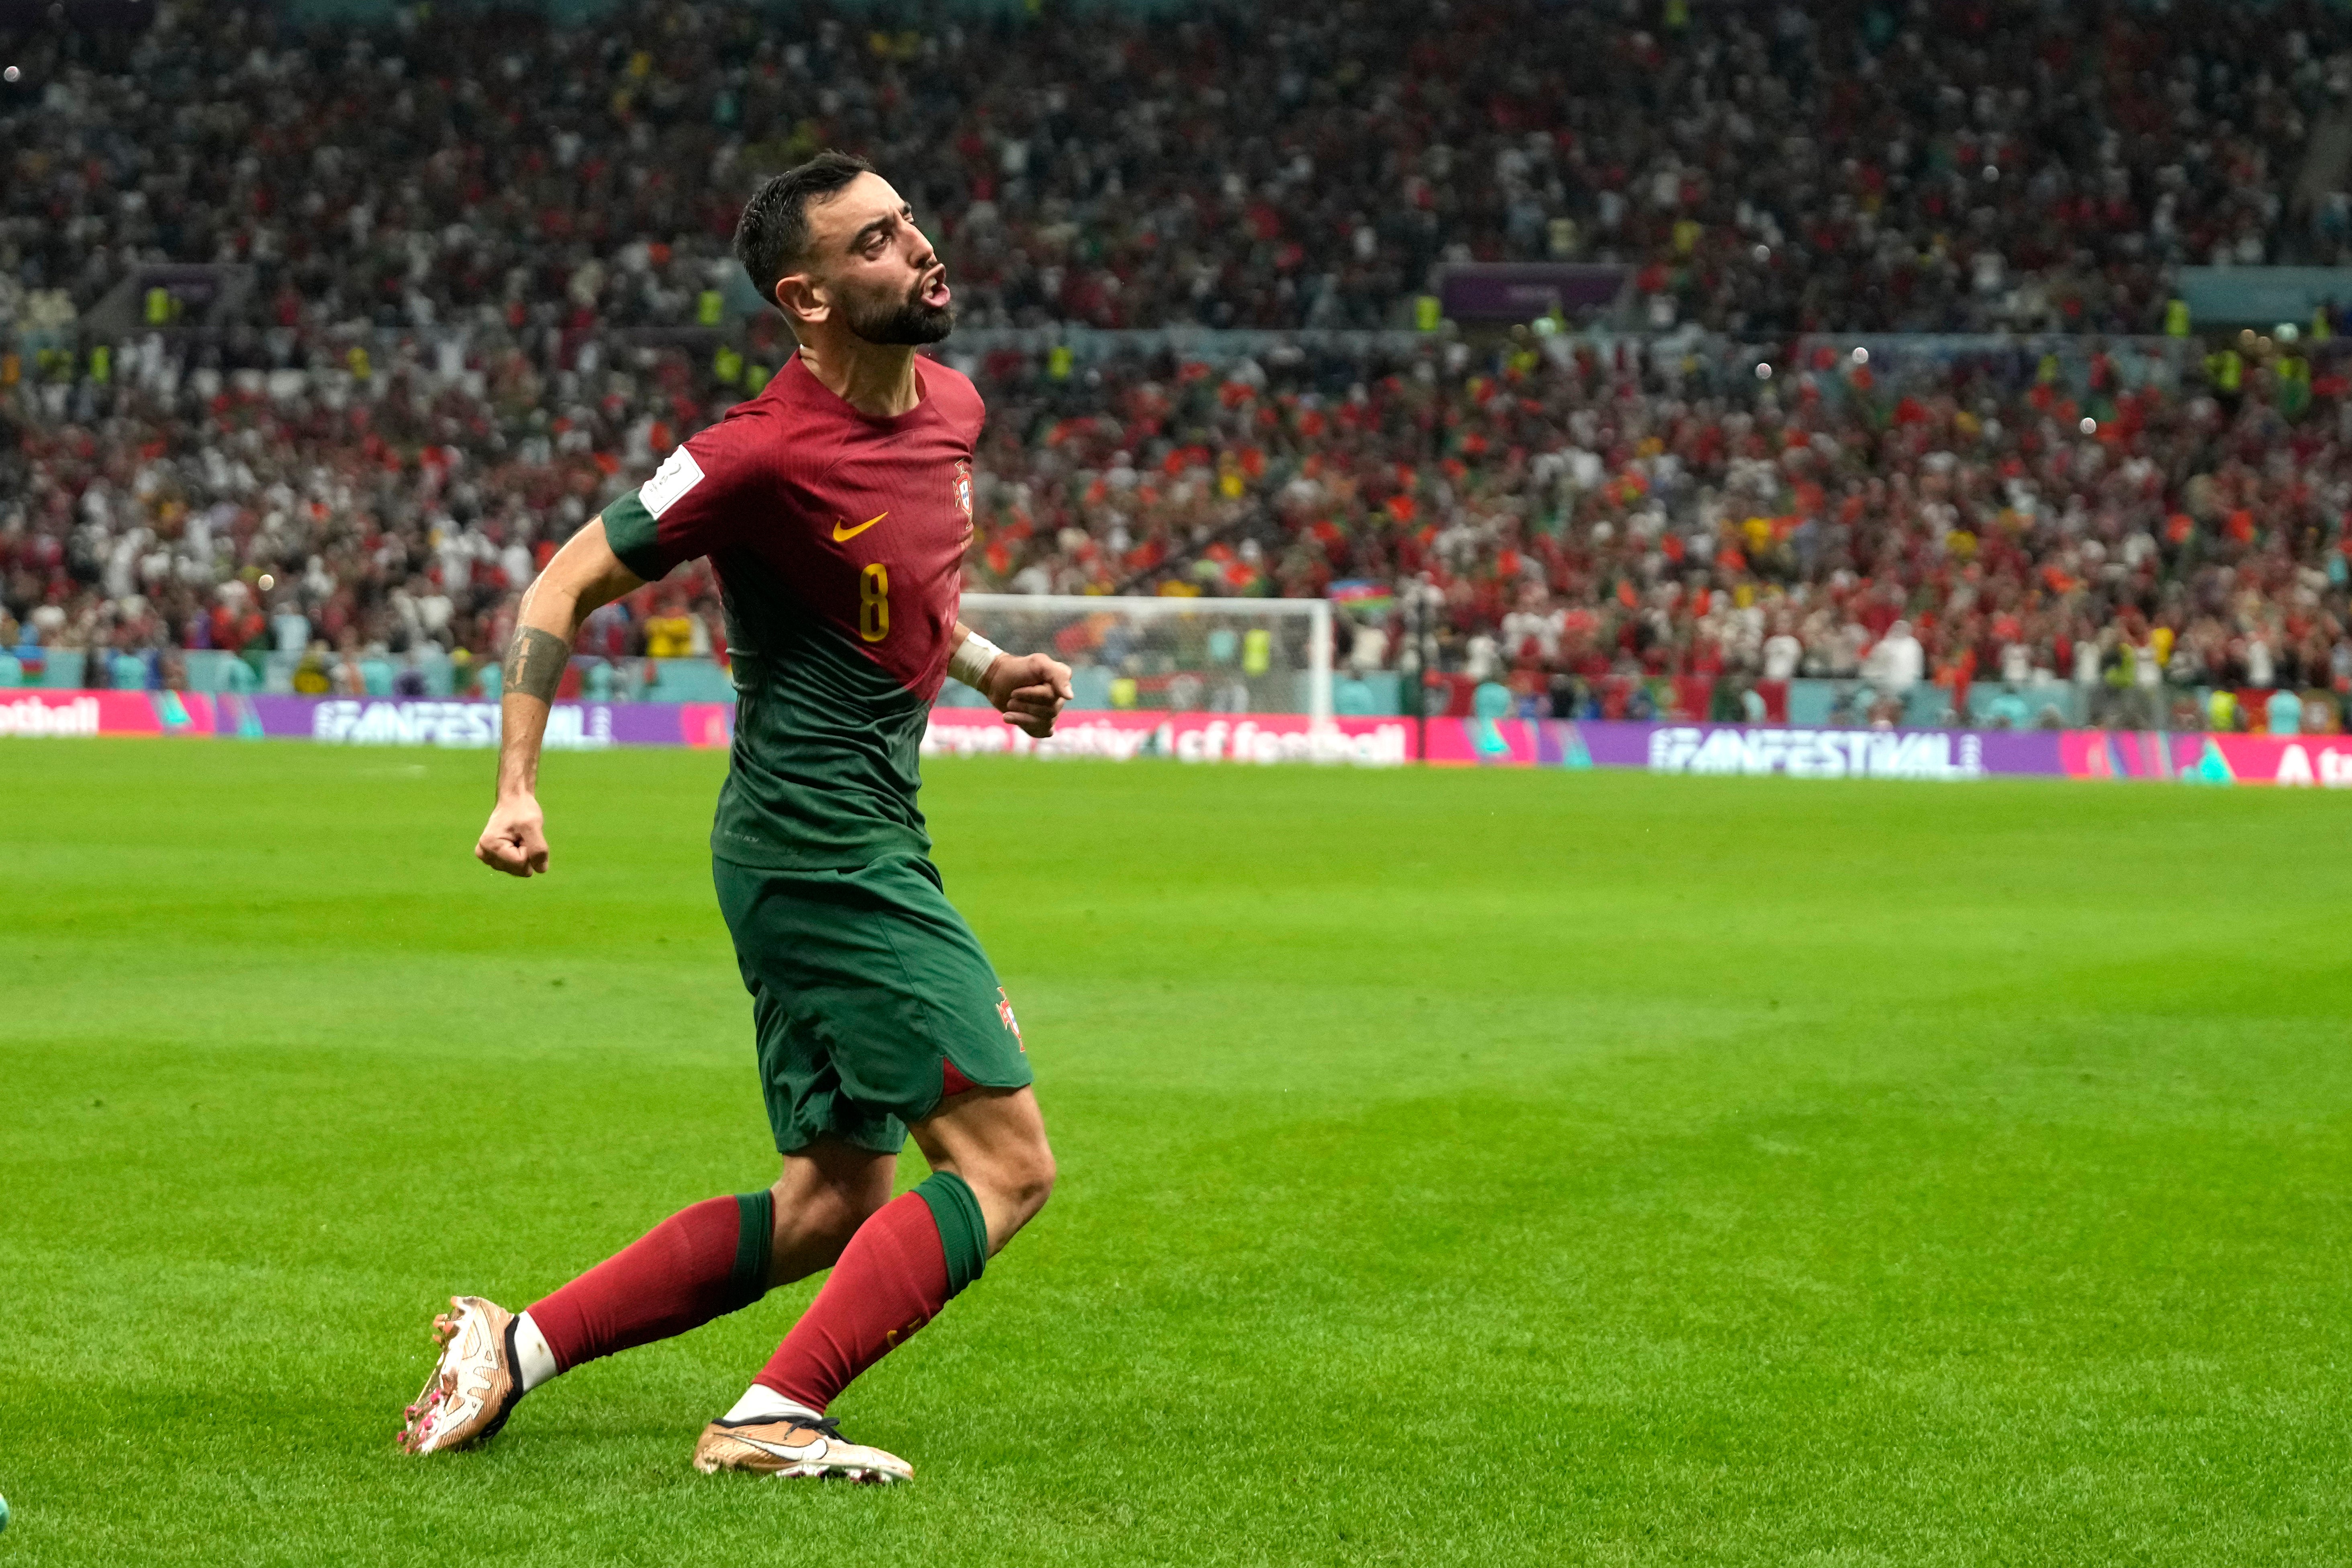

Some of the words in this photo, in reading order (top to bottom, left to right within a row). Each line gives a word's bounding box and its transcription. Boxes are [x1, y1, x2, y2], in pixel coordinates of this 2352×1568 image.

[860, 563, 889, 642] 8
[1234, 720, 1406, 767] fooball
[2277, 744, 2313, 785] A
